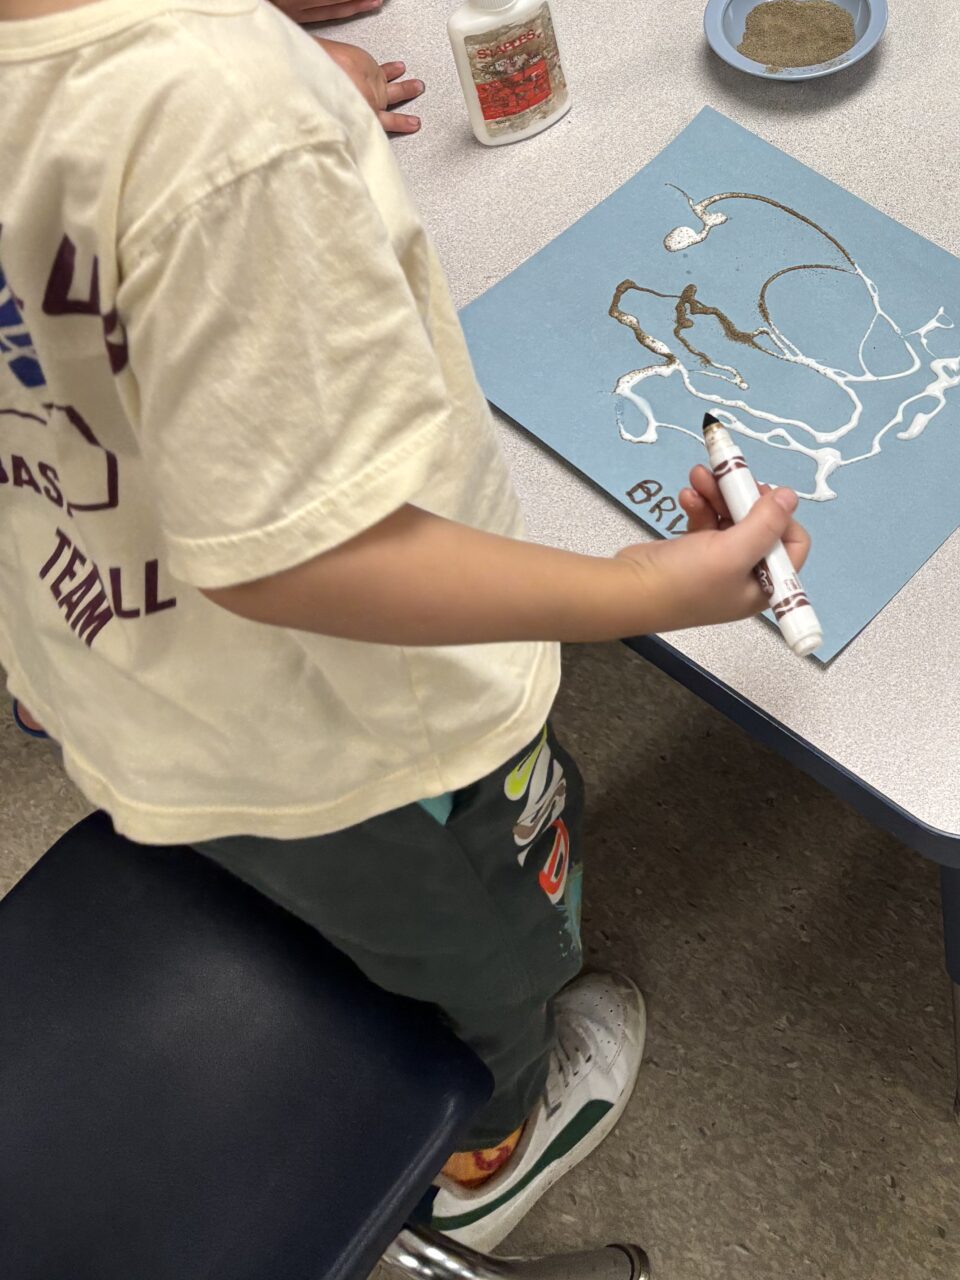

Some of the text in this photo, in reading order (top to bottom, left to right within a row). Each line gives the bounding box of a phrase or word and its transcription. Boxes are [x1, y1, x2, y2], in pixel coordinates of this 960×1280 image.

[0, 454, 64, 508] AS
[626, 479, 689, 535] BRI
[39, 527, 114, 648] TEAM
